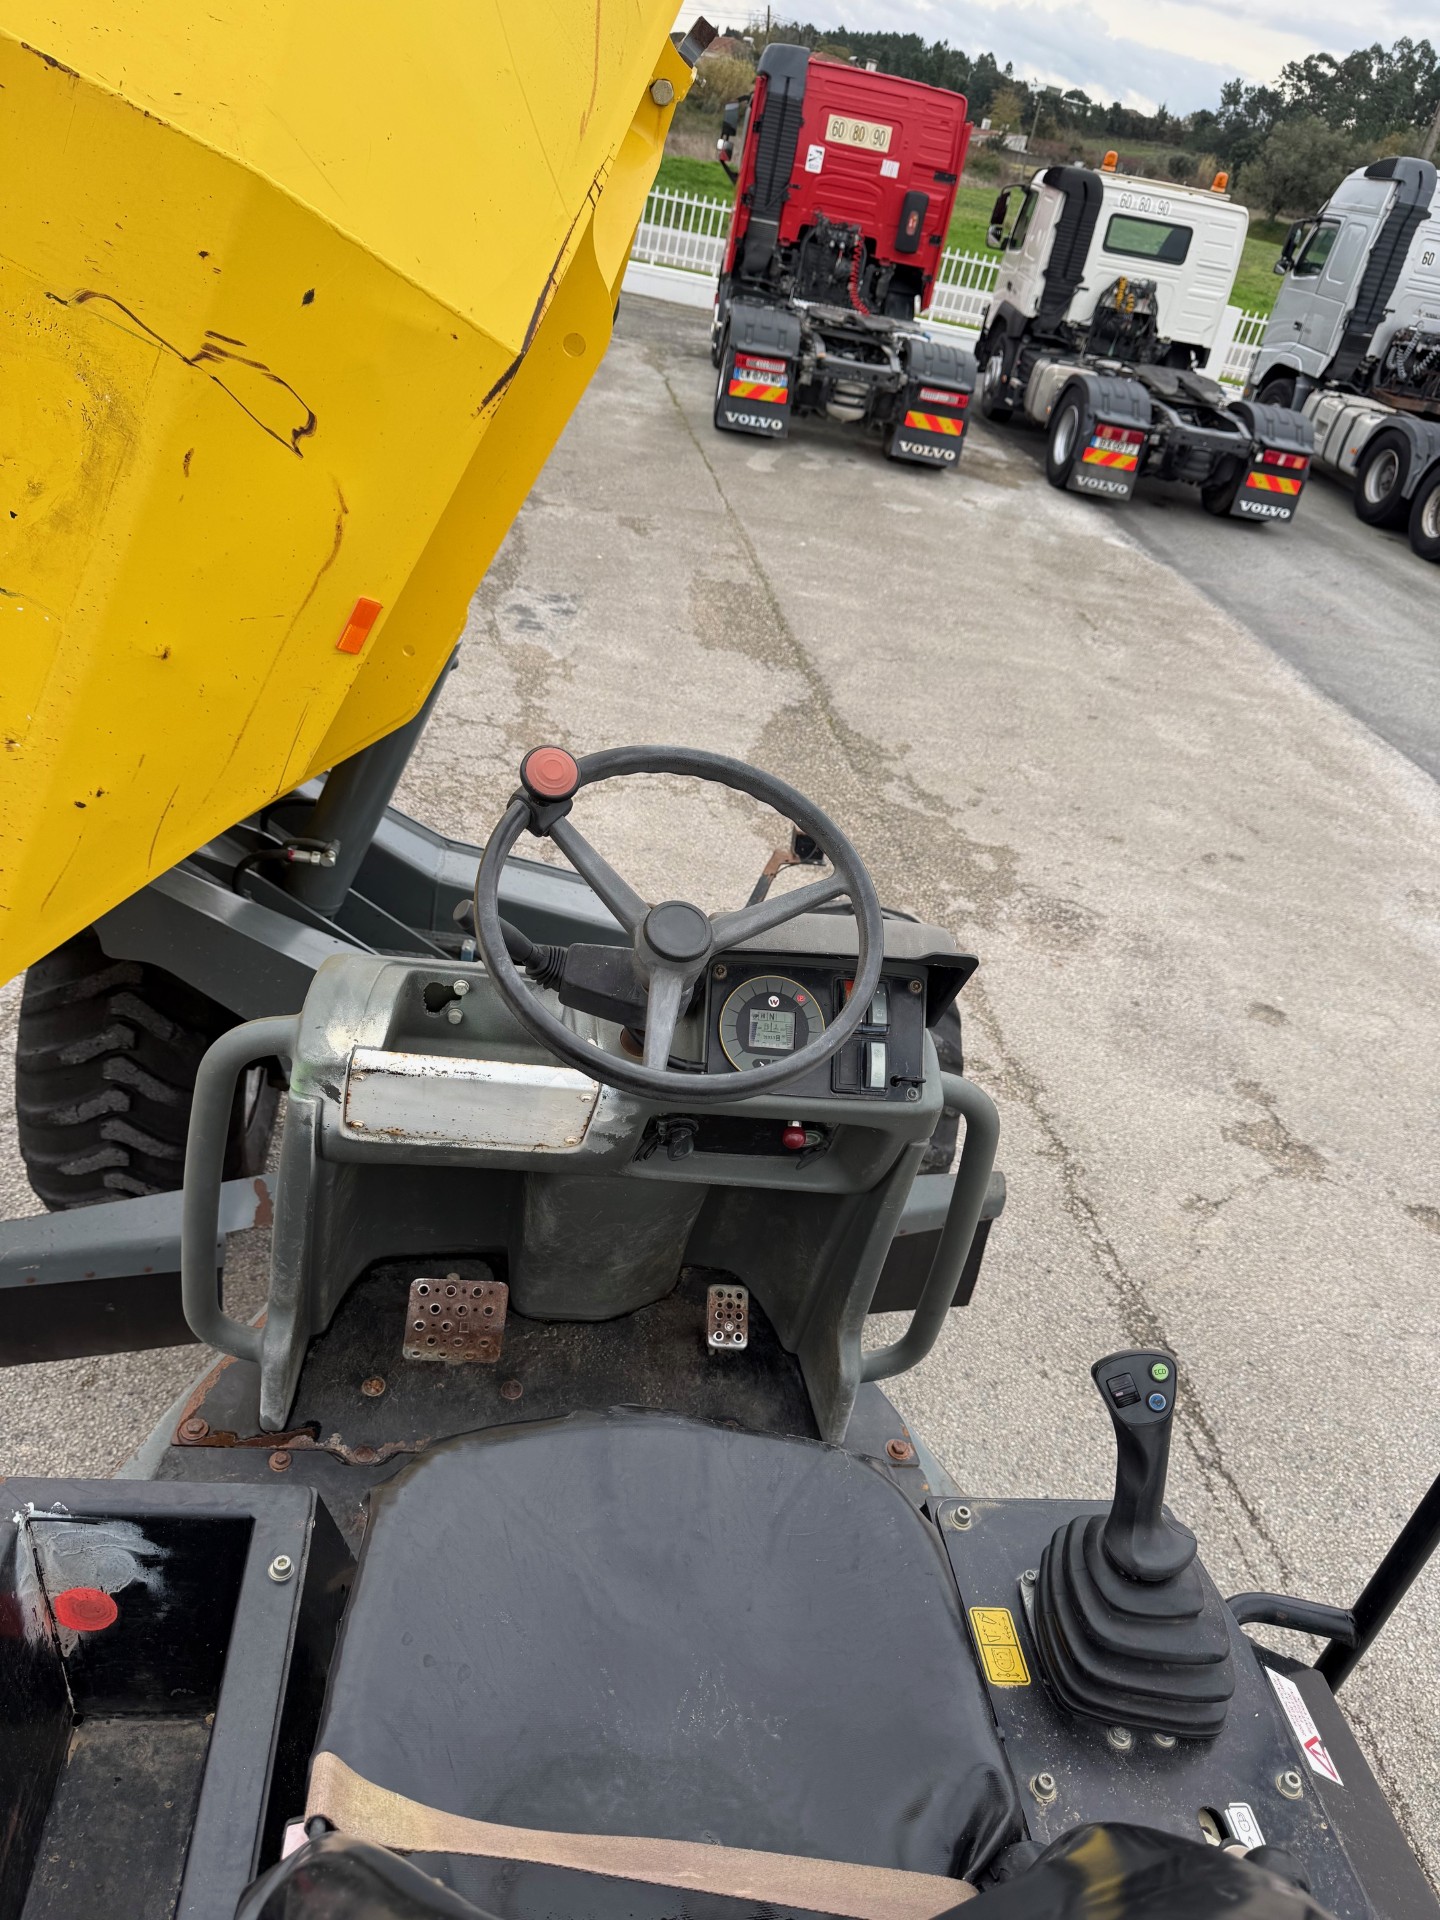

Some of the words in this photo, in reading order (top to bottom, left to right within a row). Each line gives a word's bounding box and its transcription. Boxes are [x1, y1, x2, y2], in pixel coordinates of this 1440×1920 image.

[832, 121, 845, 138] 60
[852, 125, 866, 142] 80
[873, 129, 886, 146] 90
[1120, 193, 1133, 209] 60
[1157, 200, 1170, 216] 90
[1422, 251, 1435, 266] 60
[725, 411, 783, 431] VOLVO
[899, 440, 956, 461] VOLVO
[1075, 474, 1129, 495] VOLVO
[1239, 499, 1291, 519] VOLVO
[1153, 1368, 1167, 1376] ECO
